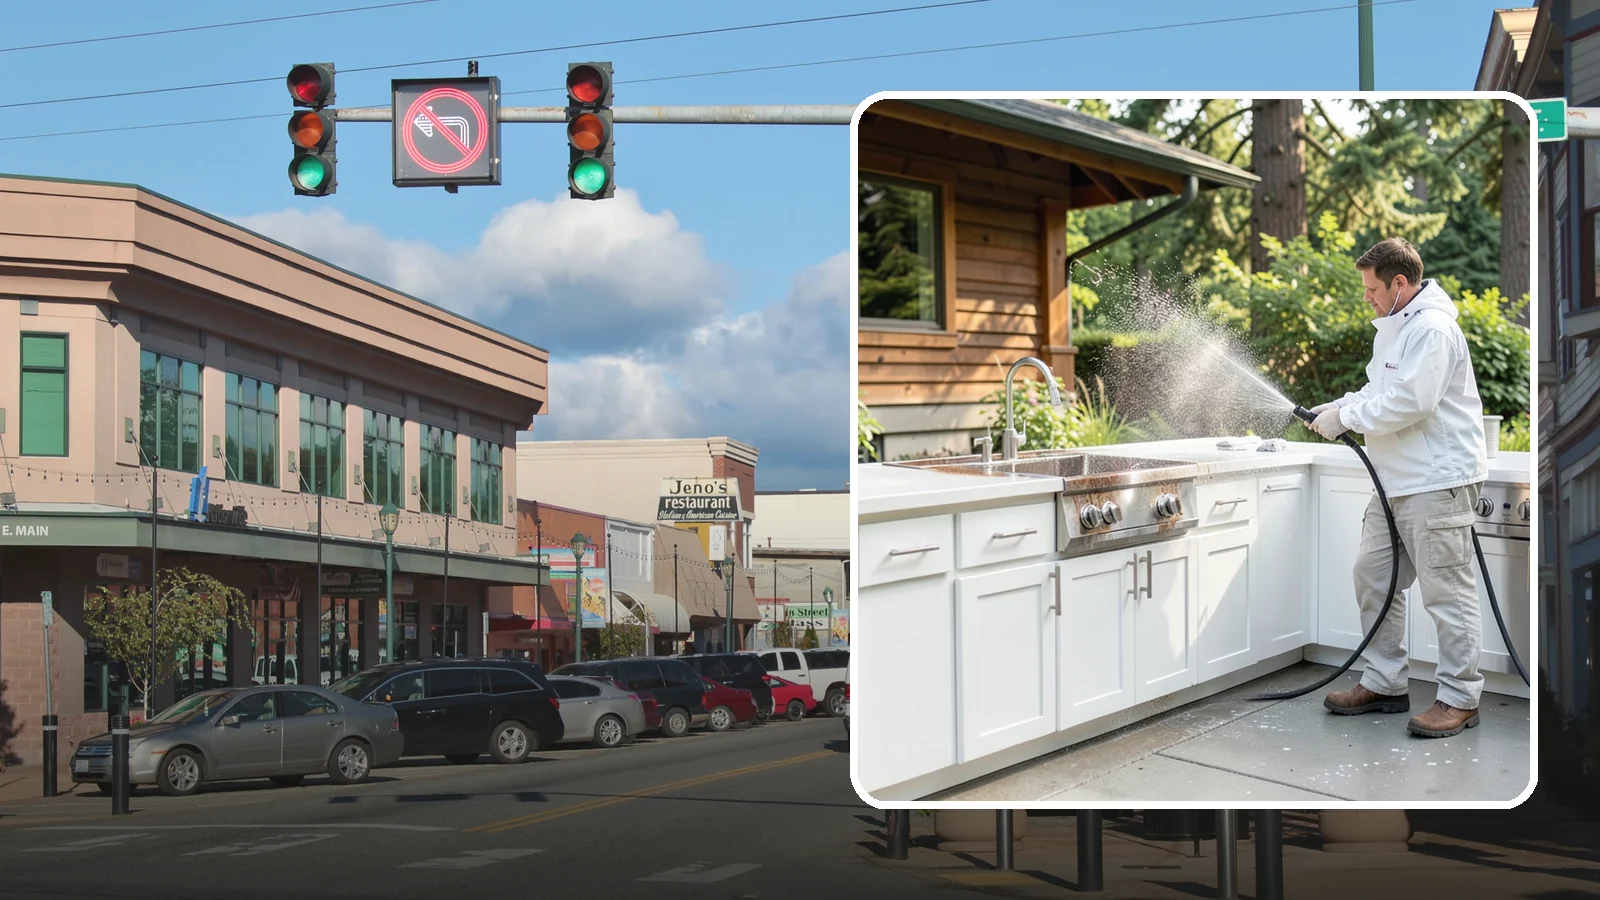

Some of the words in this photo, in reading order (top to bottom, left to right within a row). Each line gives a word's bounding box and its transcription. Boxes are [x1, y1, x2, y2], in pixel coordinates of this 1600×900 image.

[669, 480, 728, 494] Jeno's
[665, 496, 731, 509] restaurant
[658, 510, 681, 519] Italian
[686, 510, 714, 519] American
[715, 510, 737, 519] Cuisine
[2, 525, 13, 536] E.
[15, 525, 49, 536] MAIN
[797, 608, 829, 617] Street
